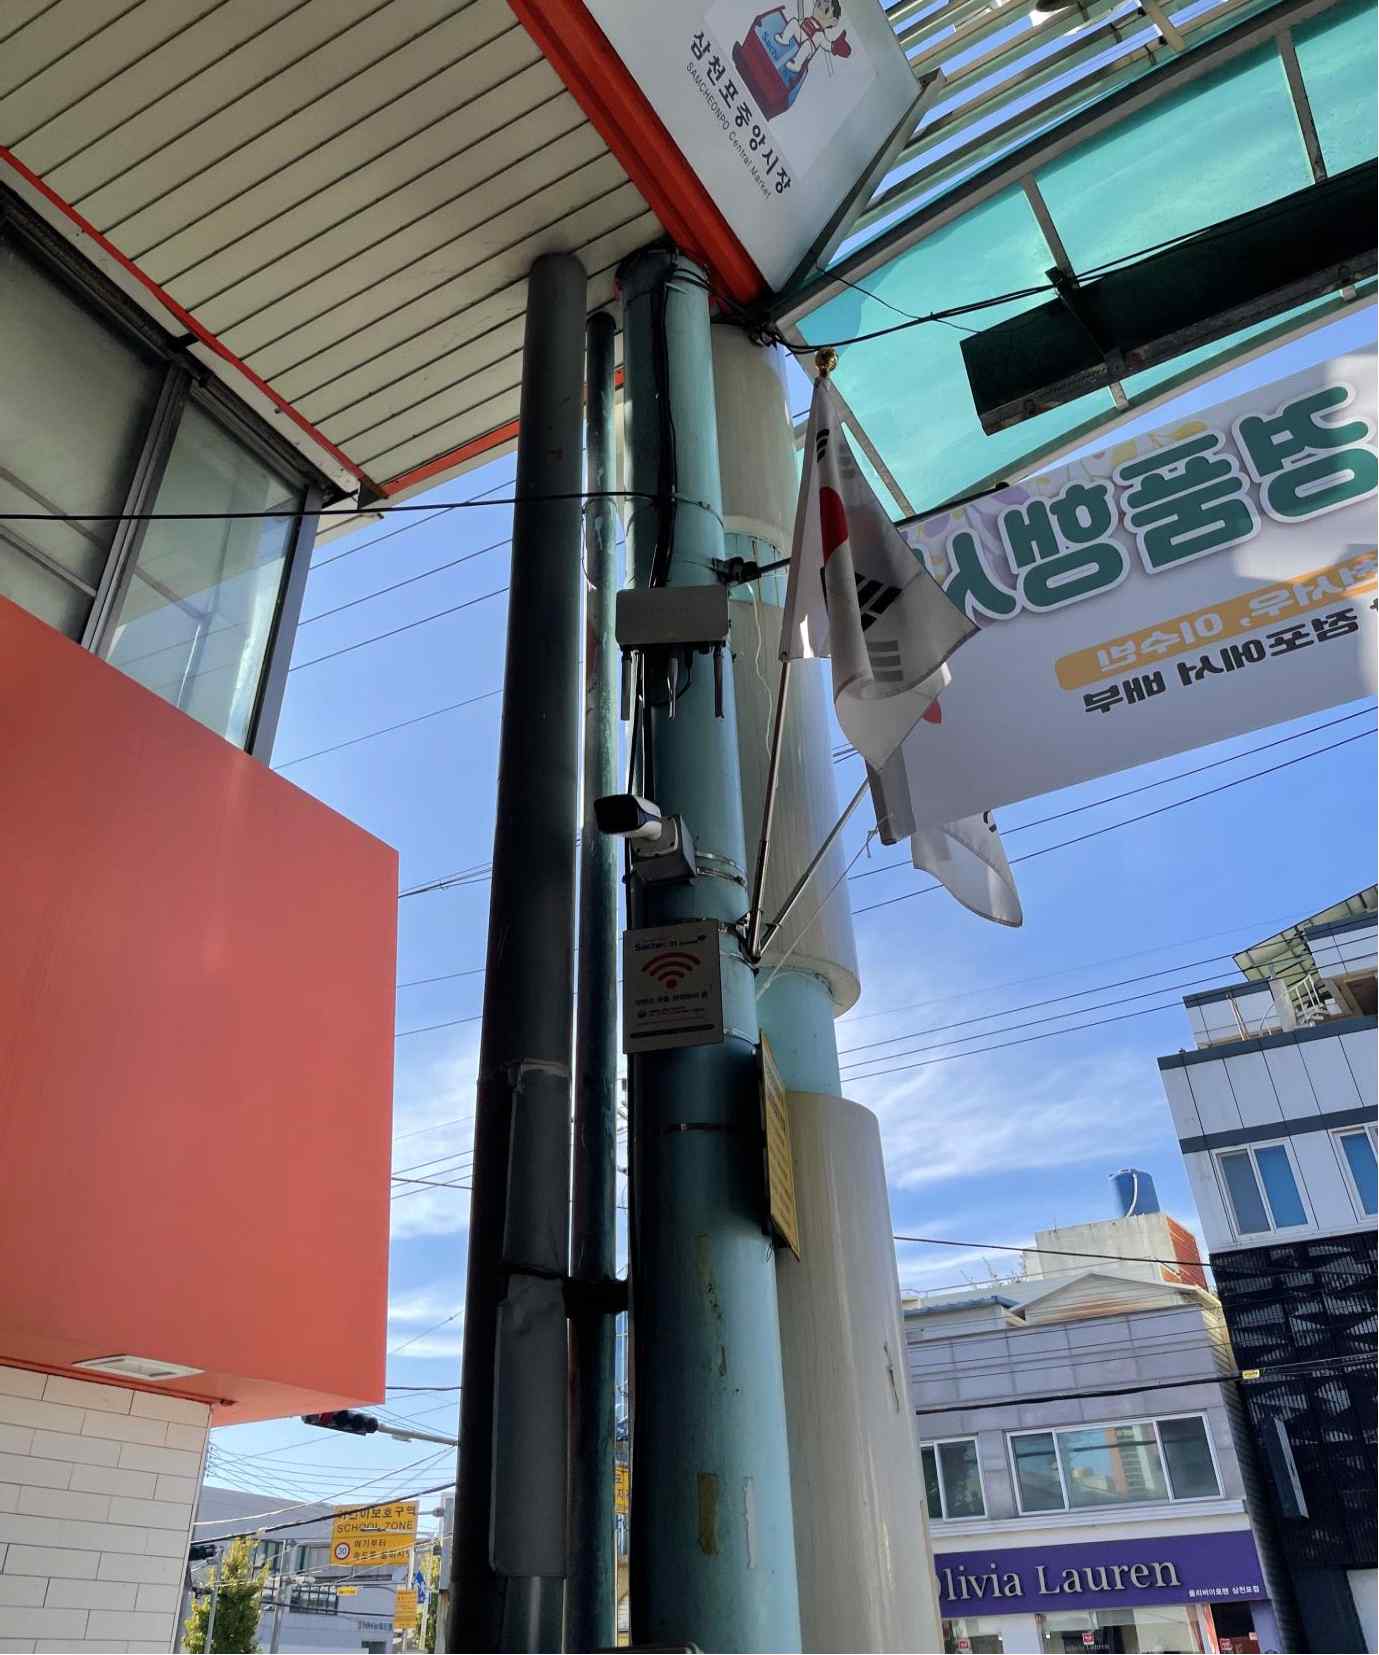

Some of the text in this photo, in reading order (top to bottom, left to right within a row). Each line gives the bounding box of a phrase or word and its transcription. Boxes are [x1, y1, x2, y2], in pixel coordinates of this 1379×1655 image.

[687, 62, 772, 199] SAMCHEONPO Central Market
[690, 32, 791, 193] 삼천포중앙시장
[385, 1520, 413, 1530] ZONE
[936, 1560, 1181, 1601] livia Lauren
